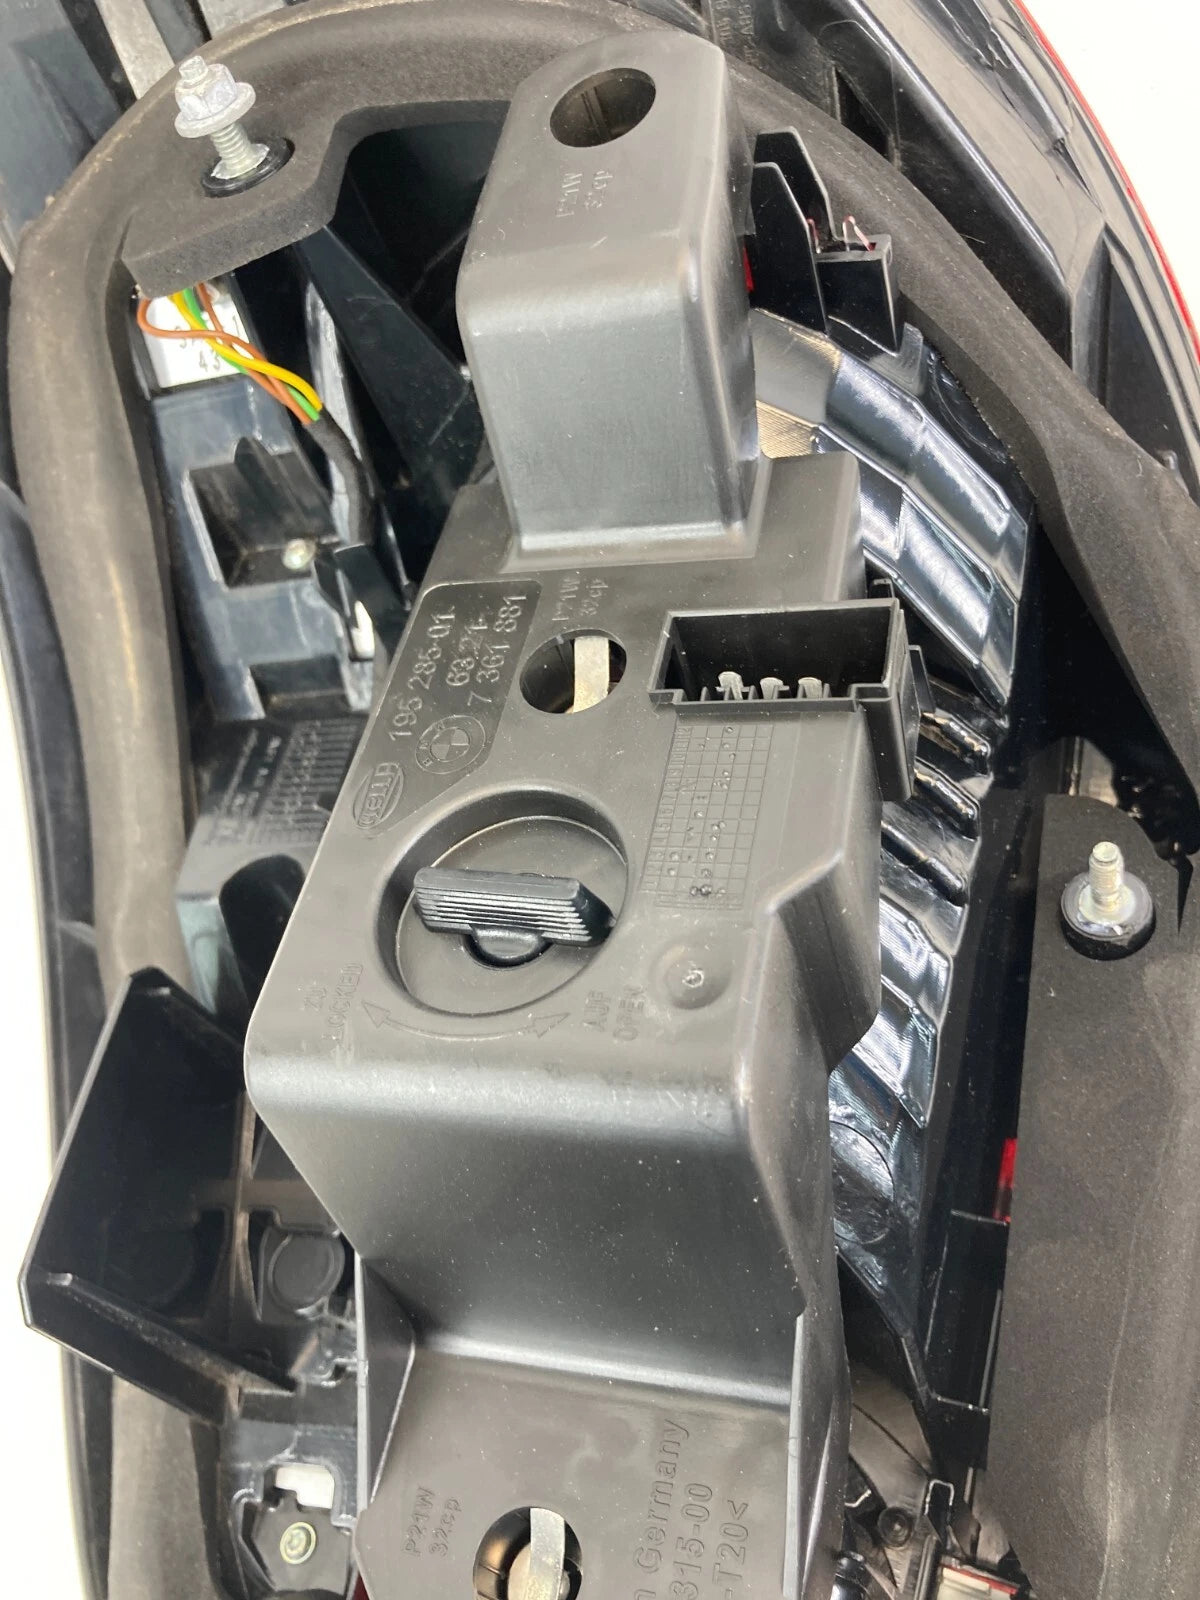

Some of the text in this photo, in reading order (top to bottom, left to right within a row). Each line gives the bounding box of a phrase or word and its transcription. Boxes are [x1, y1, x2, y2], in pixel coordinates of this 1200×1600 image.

[476, 643, 510, 683] 361
[493, 595, 527, 632] 881
[388, 697, 423, 741] 195
[403, 1486, 436, 1557] P21W
[633, 1418, 690, 1573] Germany
